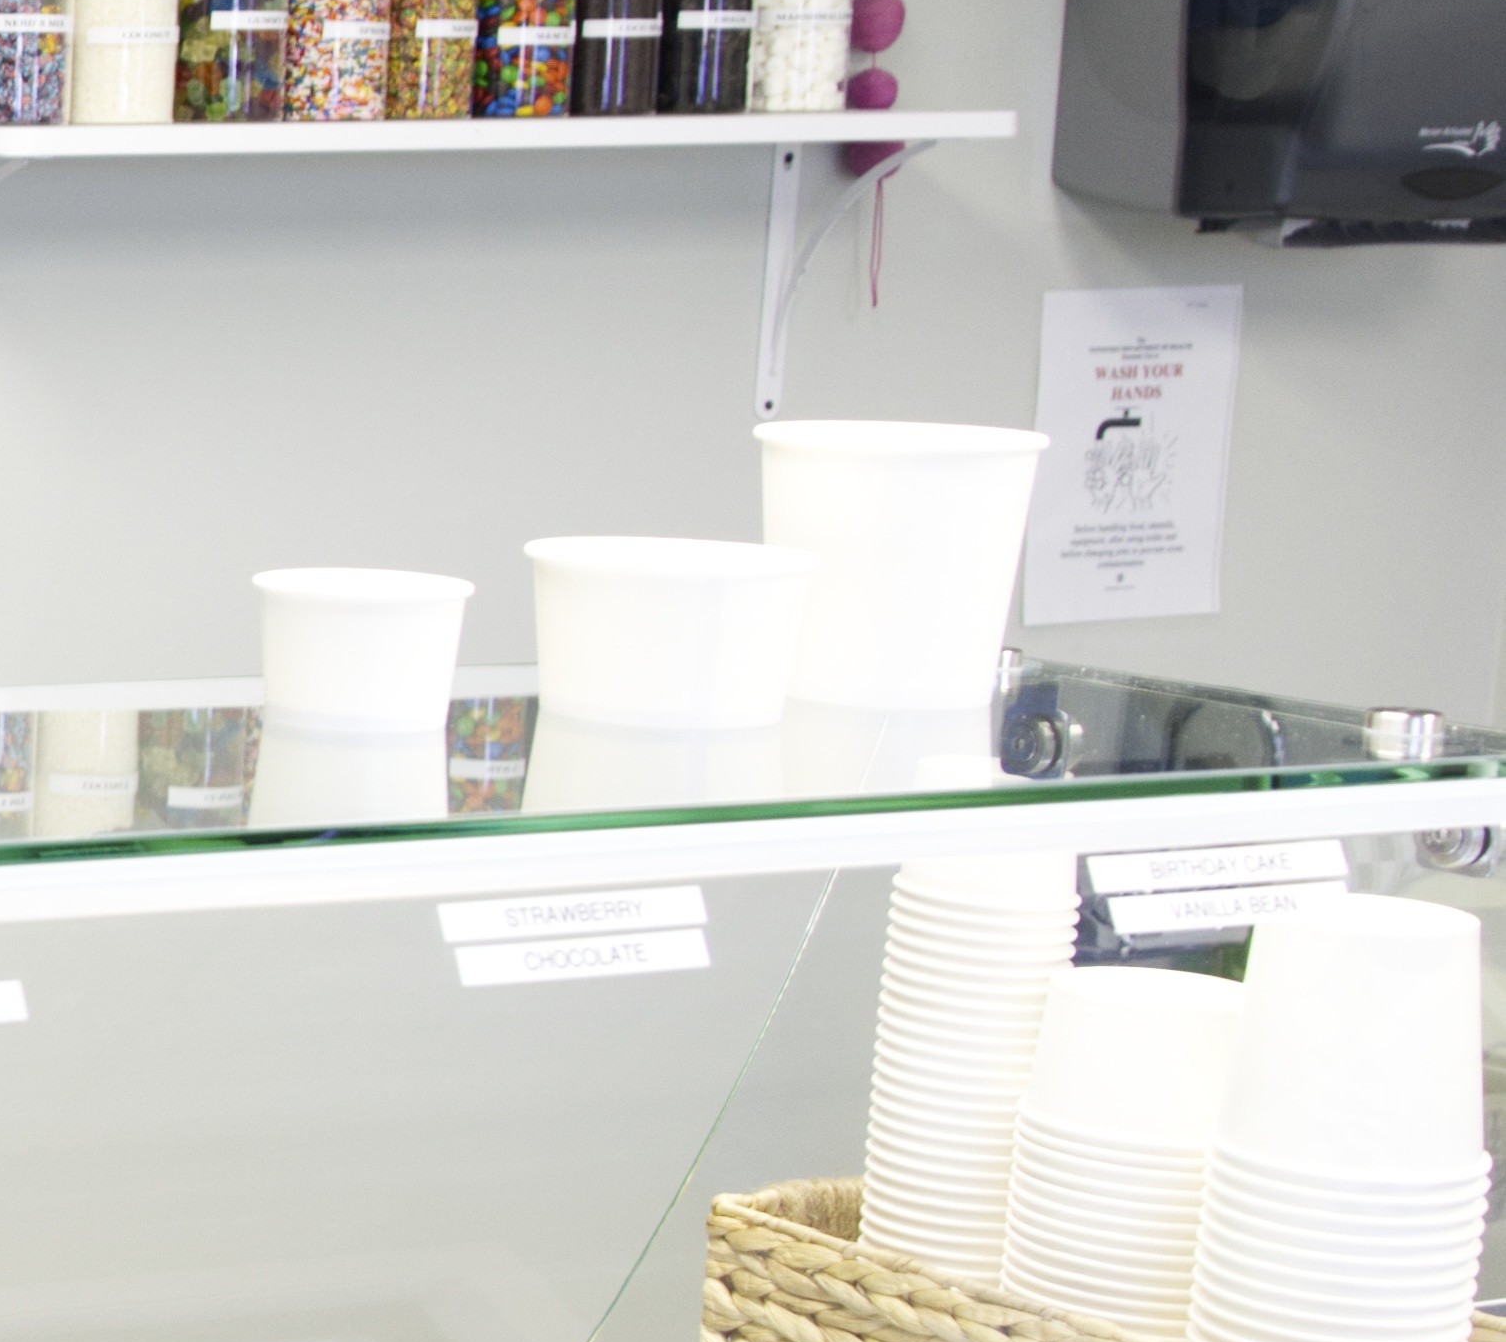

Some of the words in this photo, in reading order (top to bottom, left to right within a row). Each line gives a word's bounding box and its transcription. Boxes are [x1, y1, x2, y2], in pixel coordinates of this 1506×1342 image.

[1096, 364, 1138, 379] WASH
[1144, 363, 1183, 378] YOUR
[1112, 385, 1162, 400] HANDS
[1150, 858, 1240, 880] BIRTHDAY
[1244, 852, 1292, 872] CAKE
[505, 900, 643, 928] STRAWBERRY
[1170, 898, 1244, 920] VANILLA
[1249, 894, 1297, 914] BEAN
[524, 943, 647, 972] CHOCOLATE
